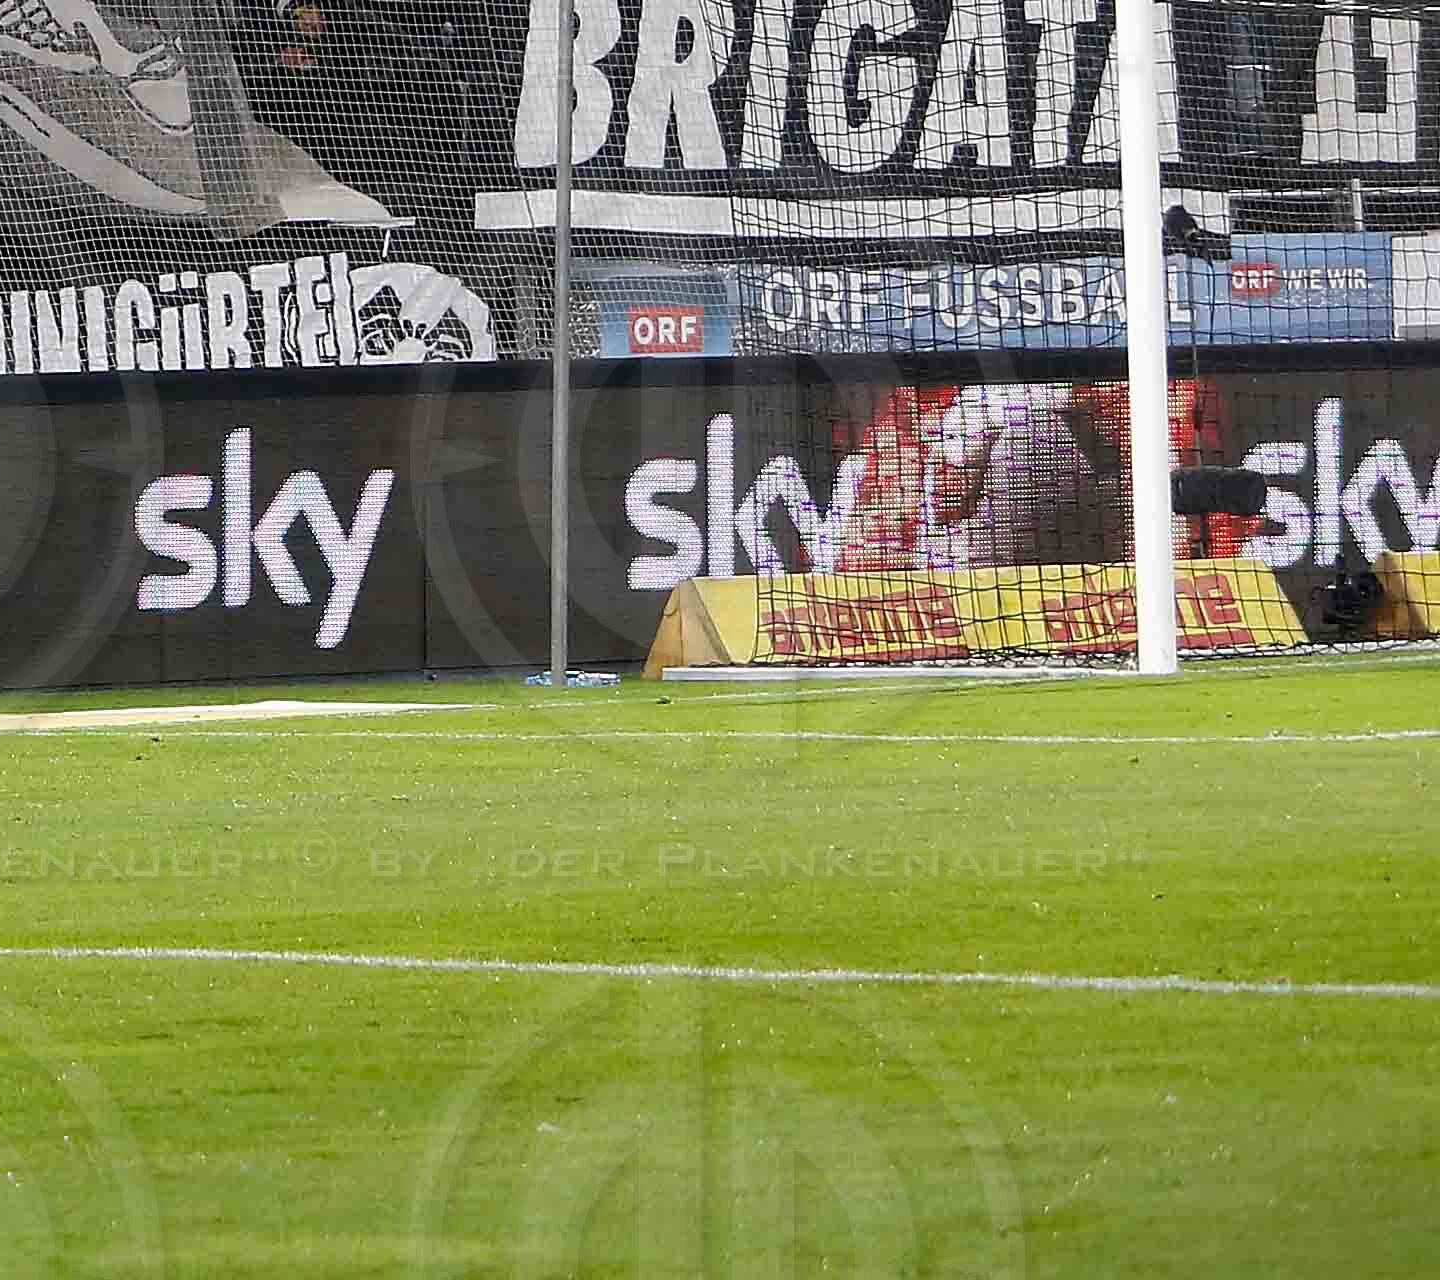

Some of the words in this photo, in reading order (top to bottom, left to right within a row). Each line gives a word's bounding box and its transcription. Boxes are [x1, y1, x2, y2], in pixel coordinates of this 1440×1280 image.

[633, 315, 697, 345] ORF
[764, 270, 880, 333] ORF
[902, 264, 1196, 329] FUSSBAL
[134, 426, 396, 651] sky
